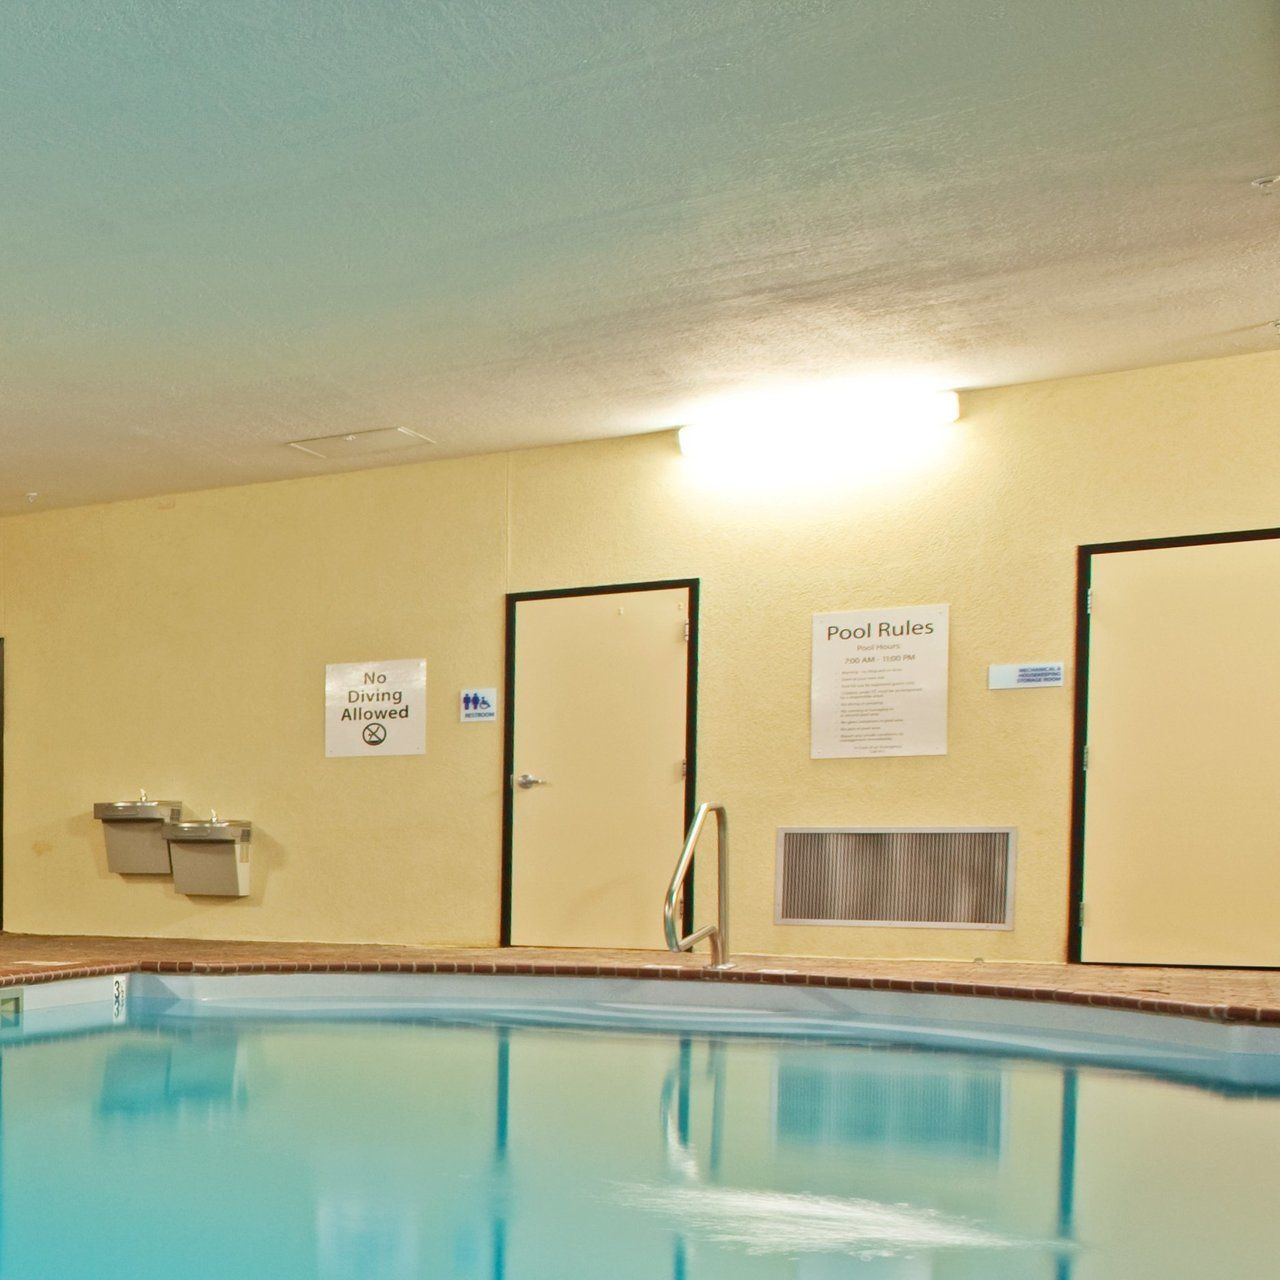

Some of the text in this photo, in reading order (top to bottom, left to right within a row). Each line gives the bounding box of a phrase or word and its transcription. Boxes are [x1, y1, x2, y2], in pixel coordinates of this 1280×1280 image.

[827, 620, 934, 641] Pool Rules
[364, 671, 387, 685] No
[348, 689, 403, 705] Diving
[341, 705, 409, 721] Allowed
